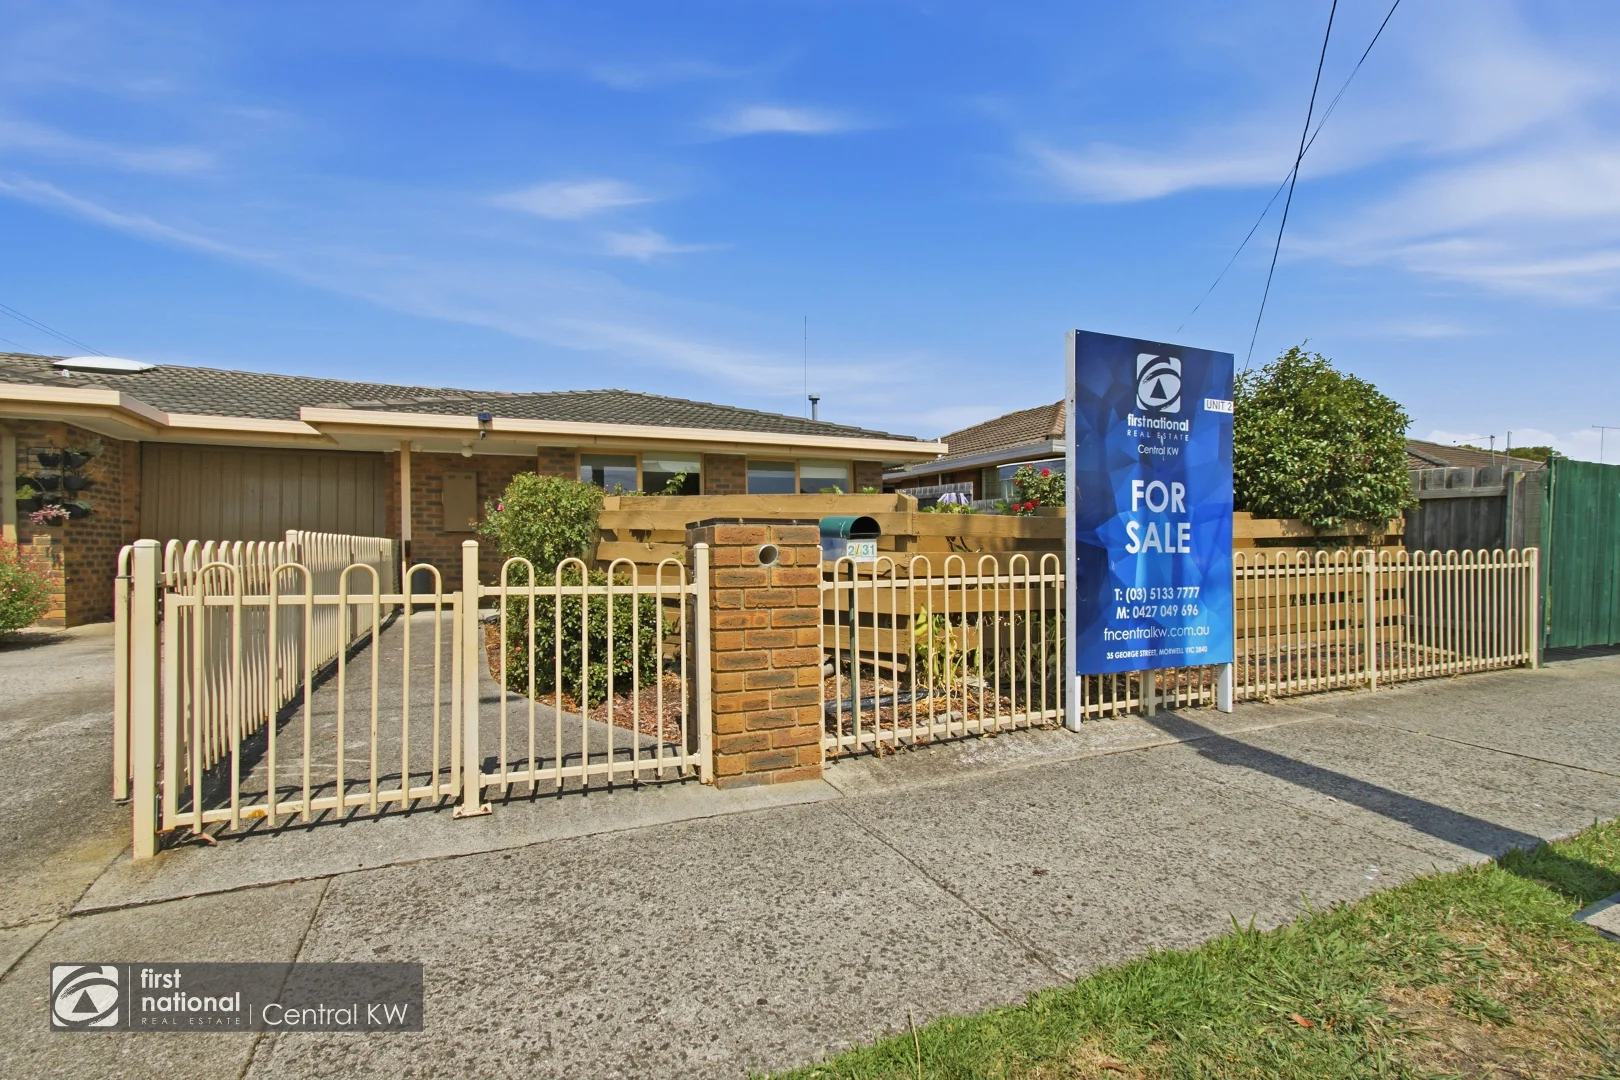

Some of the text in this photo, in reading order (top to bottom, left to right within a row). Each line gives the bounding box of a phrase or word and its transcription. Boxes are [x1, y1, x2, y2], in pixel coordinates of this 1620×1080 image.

[1206, 401, 1232, 411] UNIT 2
[1127, 429, 1189, 442] REAL ESTATE
[1137, 444, 1179, 456] Central KW
[1132, 479, 1186, 513] FOR
[1125, 520, 1191, 554] SALE
[848, 545, 875, 556] 2/31
[1114, 586, 1200, 604] T: (03) 5133 7777
[1116, 604, 1199, 619] M: 0427 049 696
[1104, 625, 1210, 641] fncentralkw.com.au
[1106, 652, 1114, 660] 35
[1114, 650, 1139, 659] GEORGE
[1158, 647, 1184, 656] MORWELL
